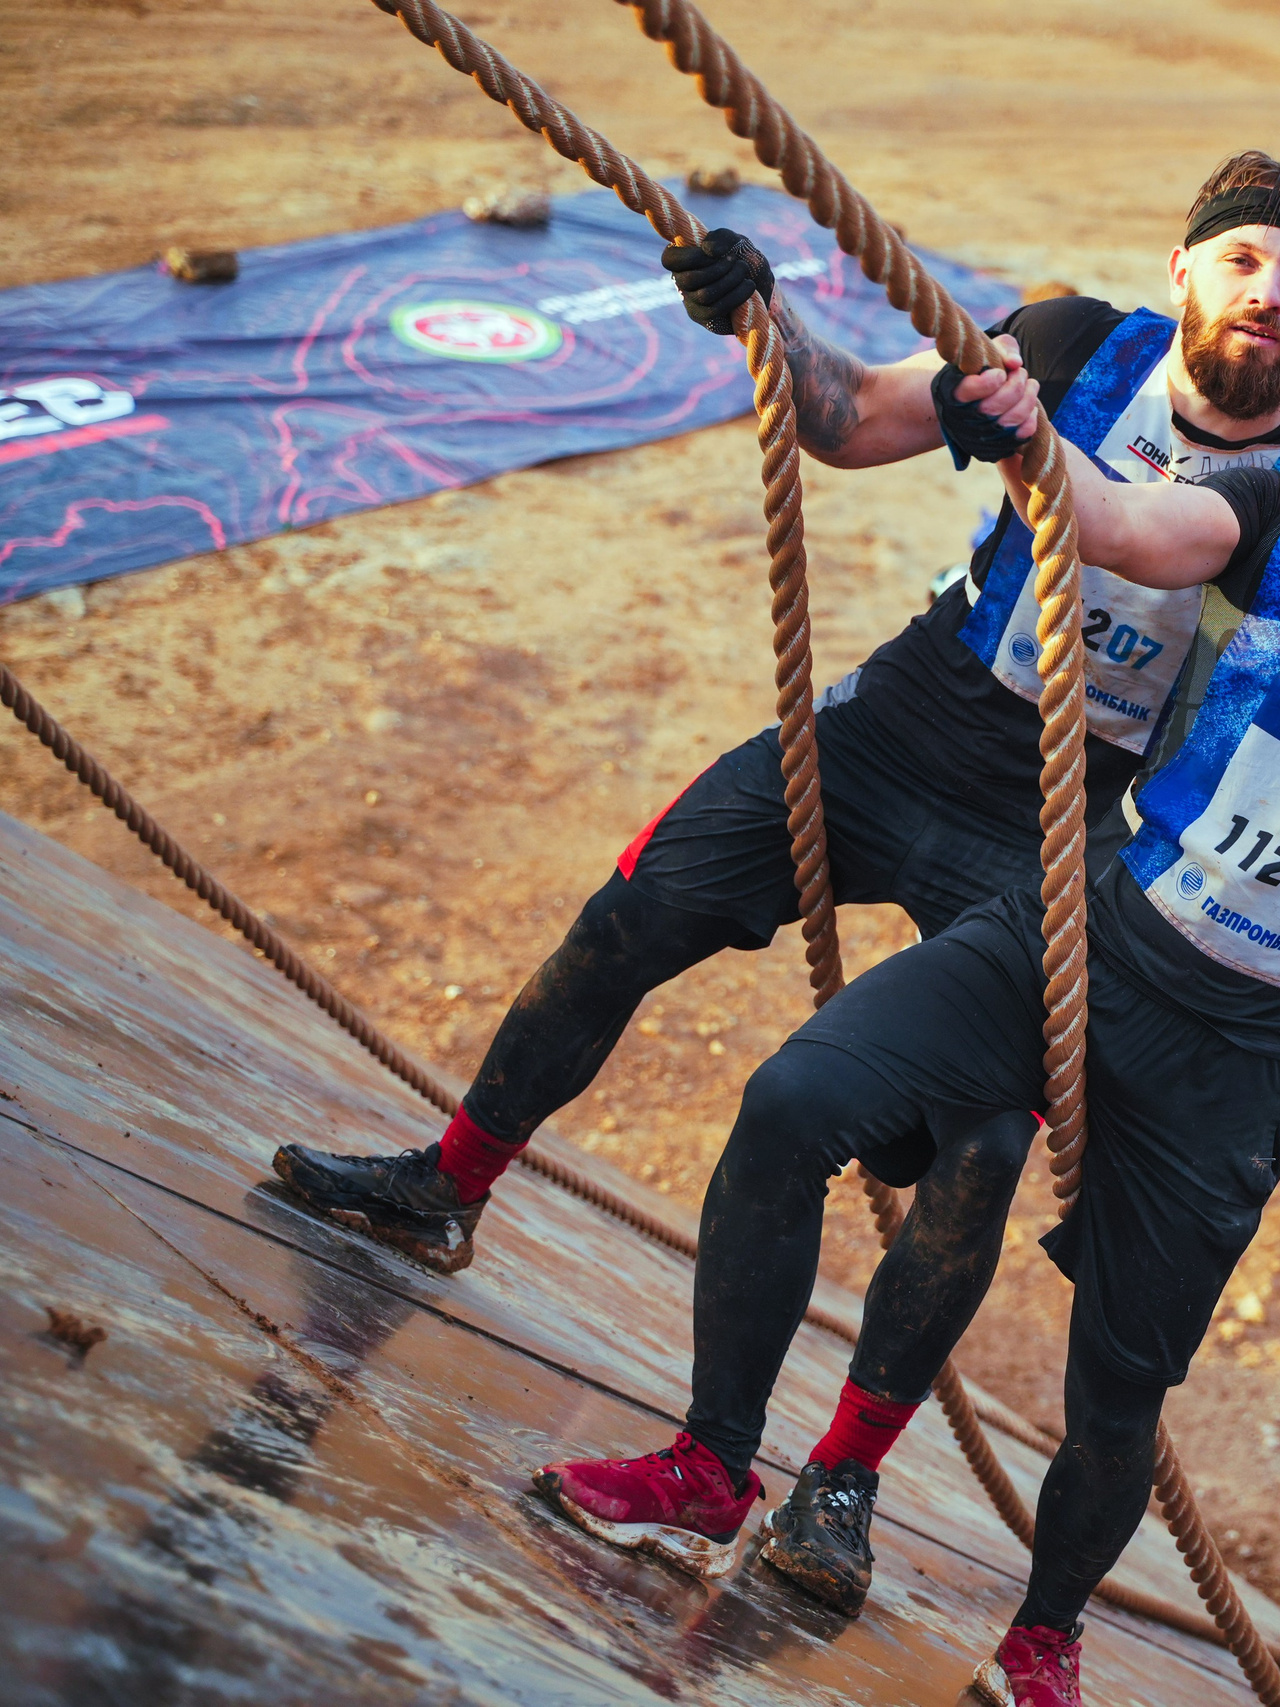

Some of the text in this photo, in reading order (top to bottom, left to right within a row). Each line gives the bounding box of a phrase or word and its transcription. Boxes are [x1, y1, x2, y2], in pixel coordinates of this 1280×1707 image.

[1133, 435, 1171, 471] ГОНК
[1081, 607, 1164, 670] 207
[1085, 685, 1151, 721] ОМБАНК
